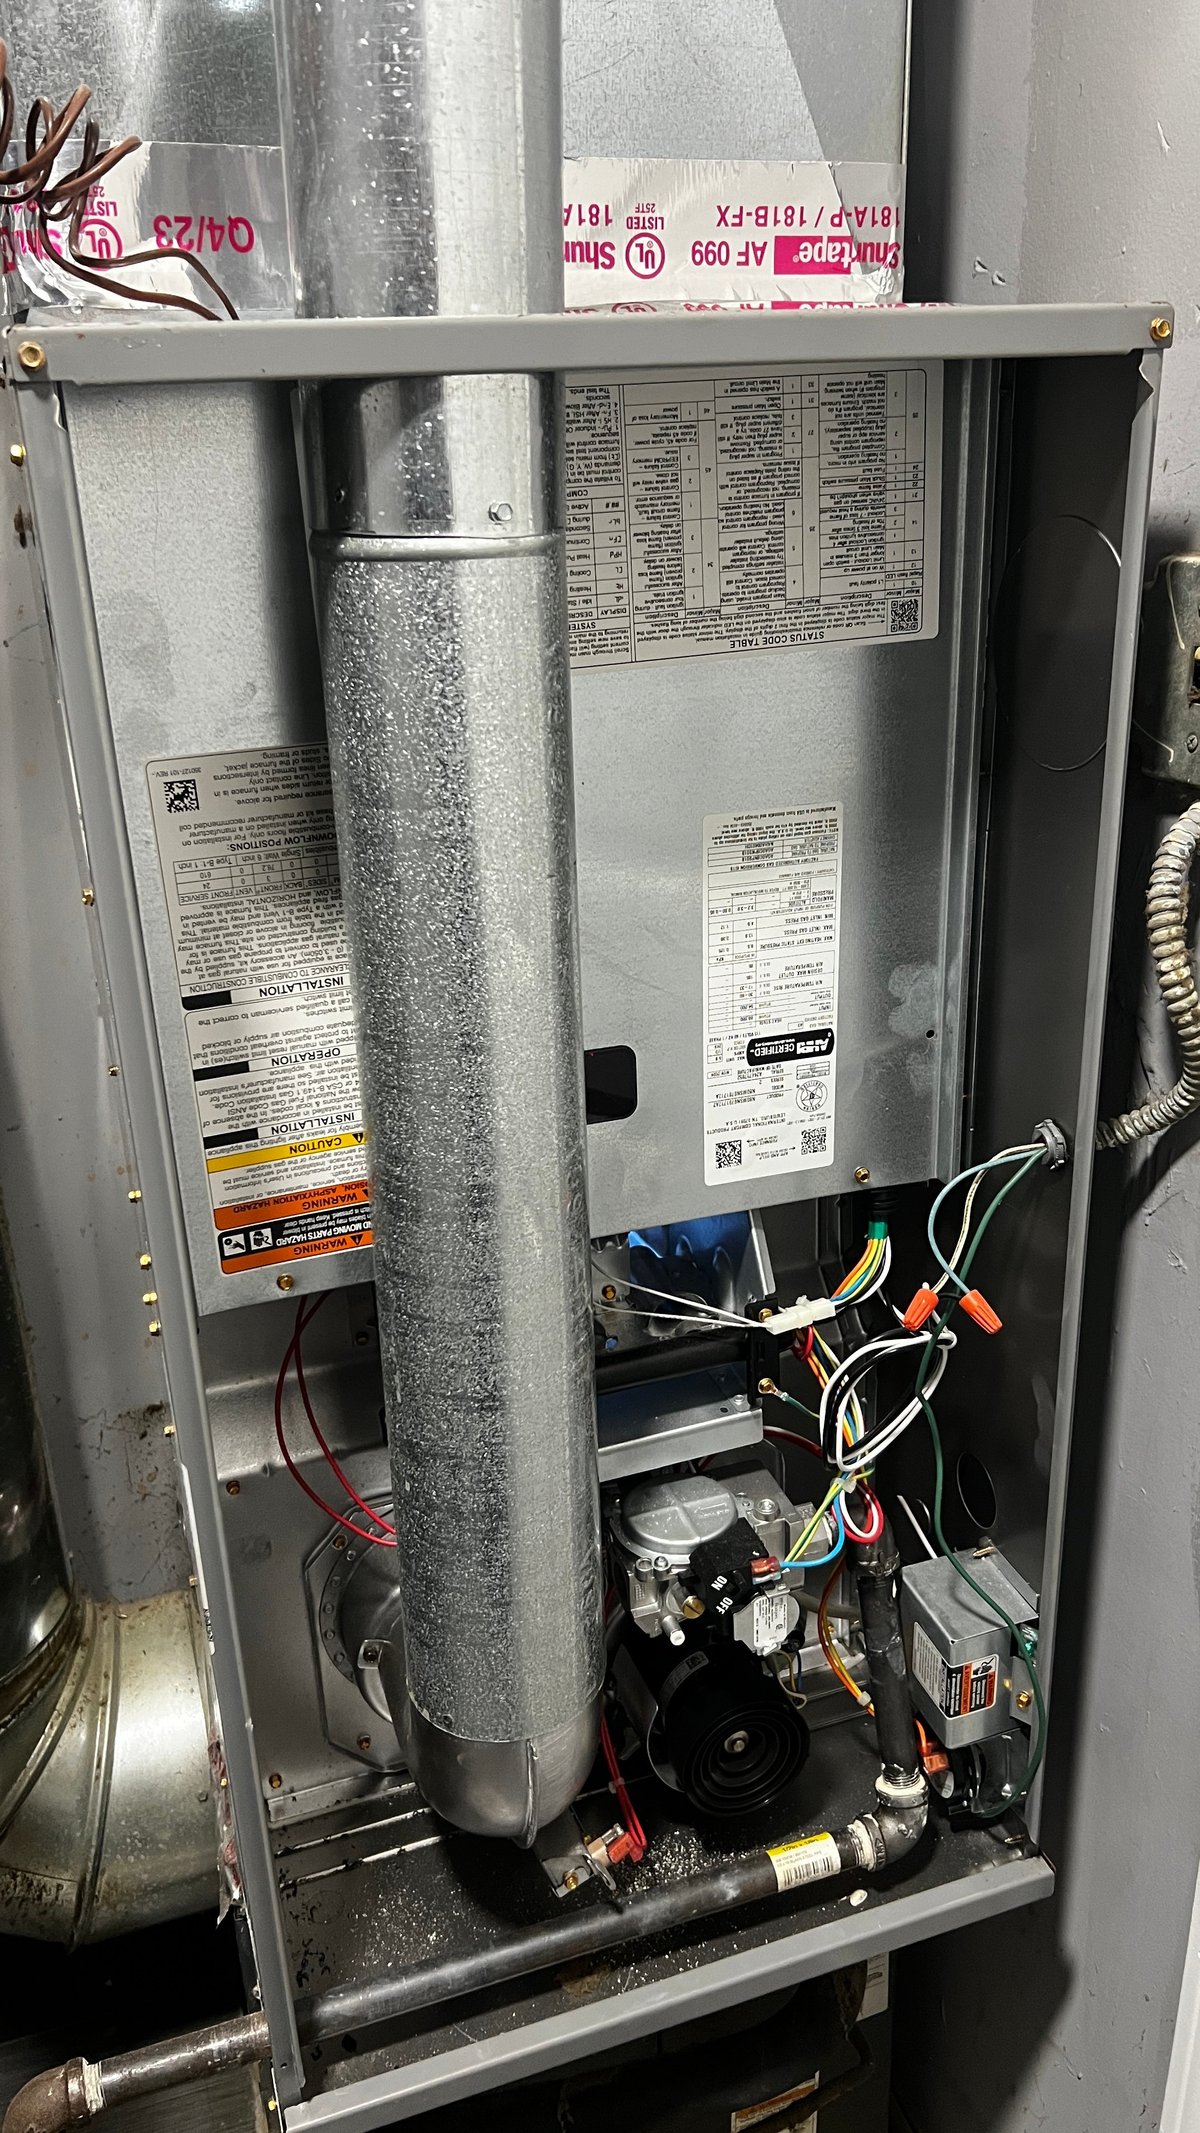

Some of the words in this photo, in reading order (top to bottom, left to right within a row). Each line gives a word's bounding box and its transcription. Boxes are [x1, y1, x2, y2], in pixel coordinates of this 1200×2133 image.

[635, 203, 655, 213] 25TF
[626, 216, 664, 230] LISTED
[716, 205, 807, 227] 181B-FX
[815, 207, 824, 227] /
[831, 206, 901, 227] 181A-P
[153, 215, 255, 253] Q4/23
[635, 242, 656, 268] UL
[692, 240, 730, 266] 099
[737, 242, 768, 266] AF
[570, 568, 591, 577] Cooling
[570, 585, 591, 593] Heating
[840, 592, 872, 601] Description
[645, 612, 678, 620] Description
[730, 638, 759, 648] TABLE
[762, 635, 787, 645] CODE
[790, 631, 824, 642] STATUS
[226, 837, 281, 852] POSITIONS:
[180, 893, 209, 903] SERVICE
[210, 890, 233, 899] FRONT
[235, 887, 252, 896] VENT
[248, 971, 297, 985] COMBUSTIBLE
[299, 969, 309, 977] TO
[189, 978, 246, 993] CONSTRUCTION
[259, 976, 343, 997] INSTALLATION
[271, 1047, 340, 1066] OPERATION
[755, 1043, 794, 1057] CERTIFIED
[271, 1112, 355, 1135] INSTALLATION
[289, 1137, 342, 1154] CAUTION
[273, 1187, 336, 1205] ASPHYXIATION
[302, 1193, 357, 1210] WARNING
[233, 1200, 270, 1213] HAZARD
[307, 1228, 331, 1240] PARTS
[333, 1222, 362, 1235] MOVING
[276, 1233, 306, 1247] HAZARD
[293, 1237, 347, 1256] WARNING
[711, 1575, 728, 1591] ON
[716, 1597, 733, 1615] OFF
